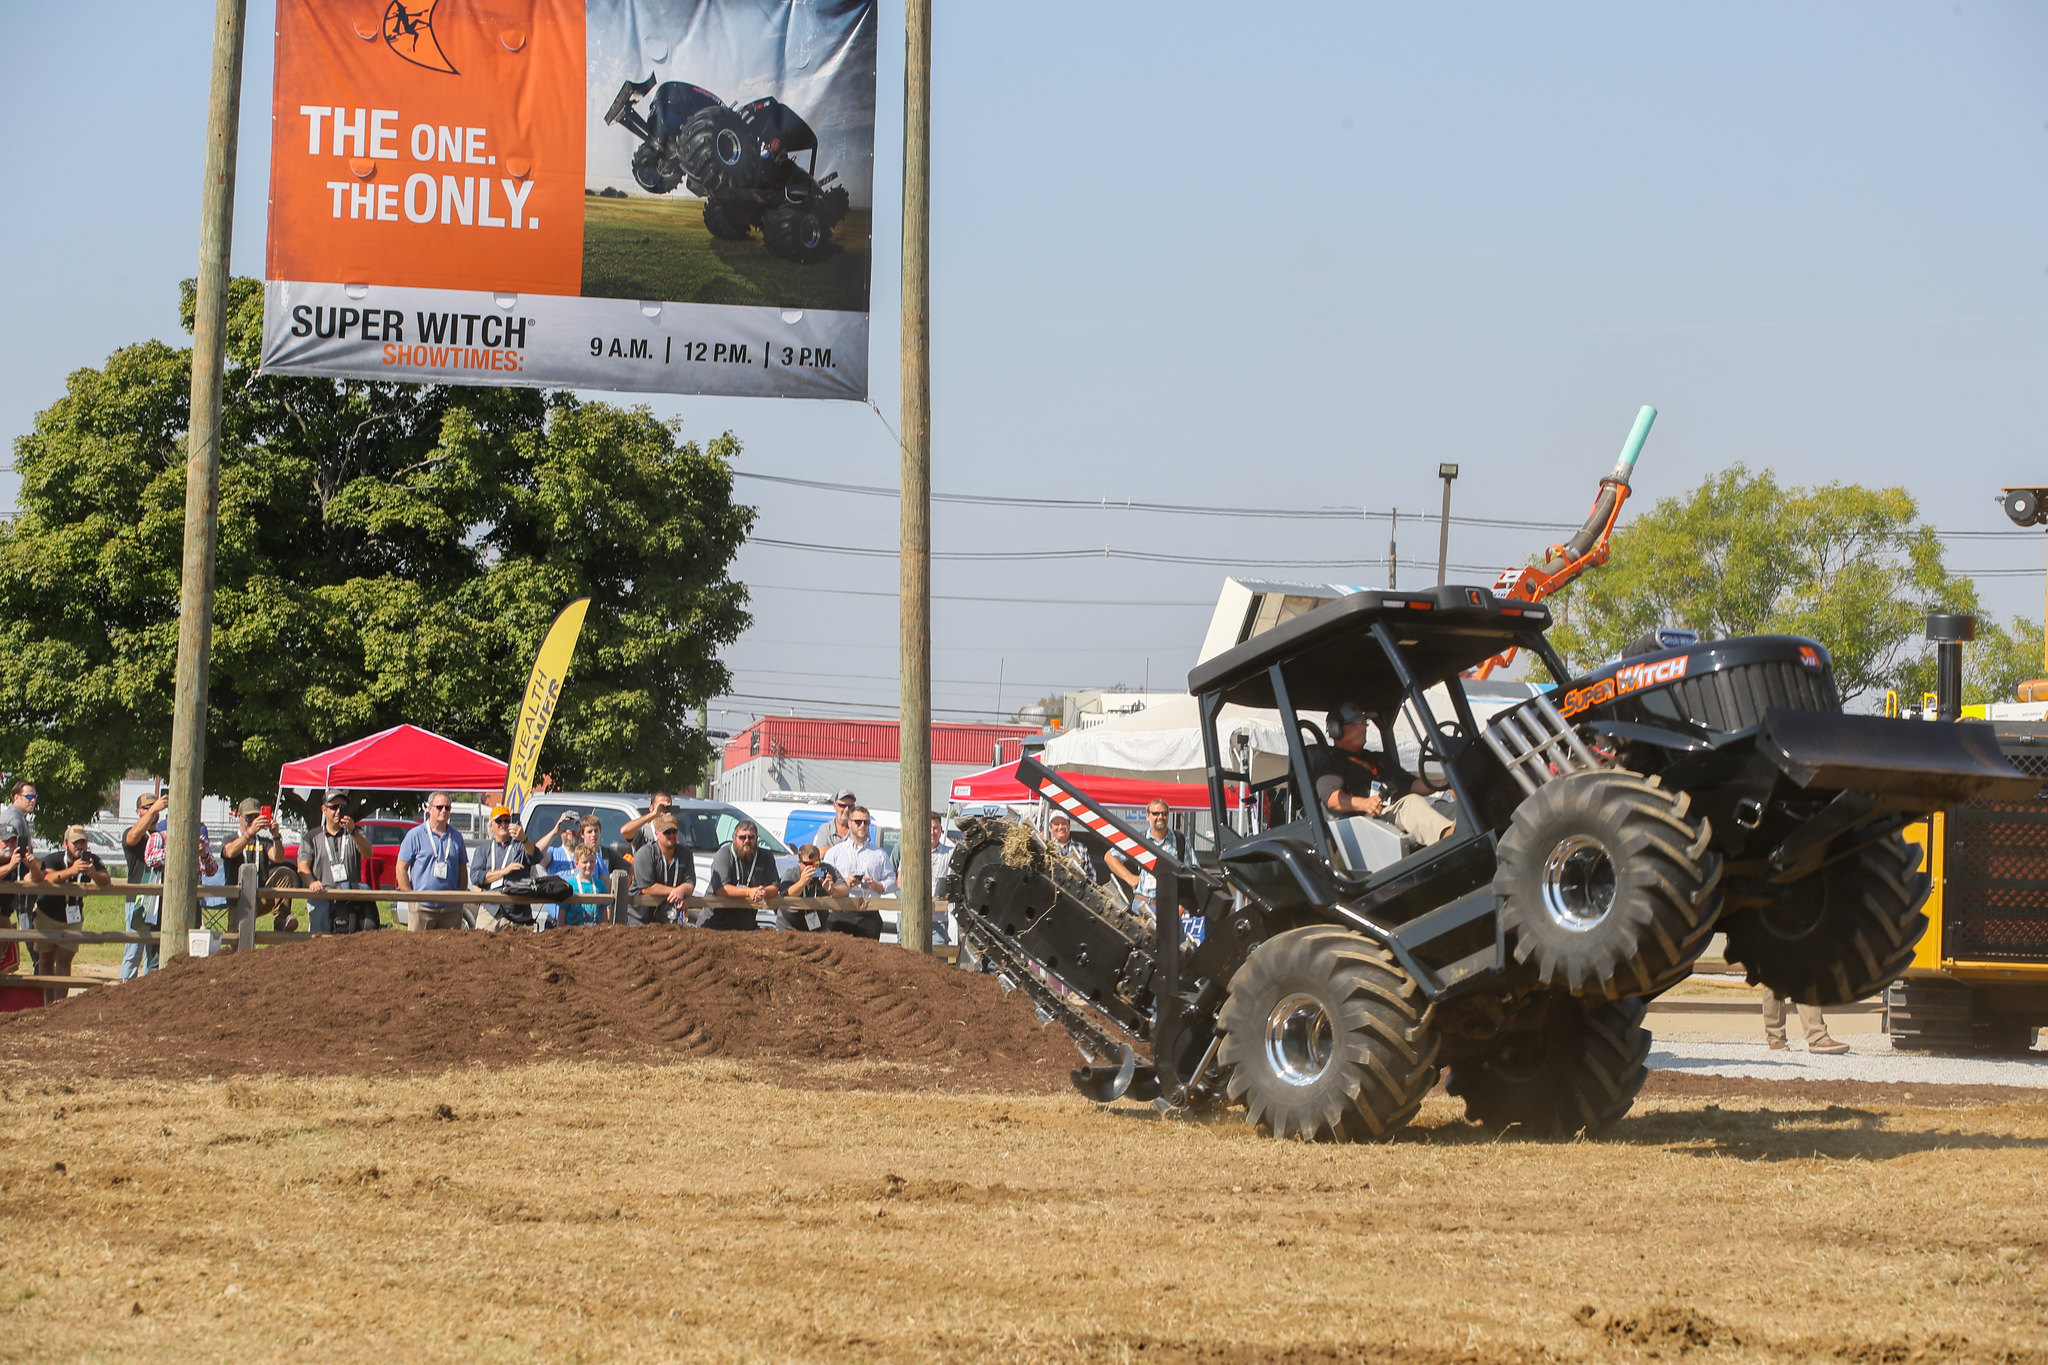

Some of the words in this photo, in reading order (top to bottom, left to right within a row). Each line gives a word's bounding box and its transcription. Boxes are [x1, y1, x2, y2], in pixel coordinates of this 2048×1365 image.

[300, 105, 399, 160] THE
[411, 123, 496, 165] ONE.
[327, 181, 399, 221] THE
[404, 173, 540, 230] ONLY.
[291, 304, 404, 342] SUPER
[382, 343, 524, 372] SHOWTIMES:
[590, 337, 603, 357] 9
[608, 338, 653, 360] A.M.
[684, 341, 708, 362] 12
[713, 343, 752, 364] P.M.
[781, 346, 794, 366] 3
[799, 347, 837, 368] P.M.
[1558, 677, 1616, 718] SUPER
[1616, 655, 1688, 694] WITCH
[515, 668, 548, 778] STEALTH
